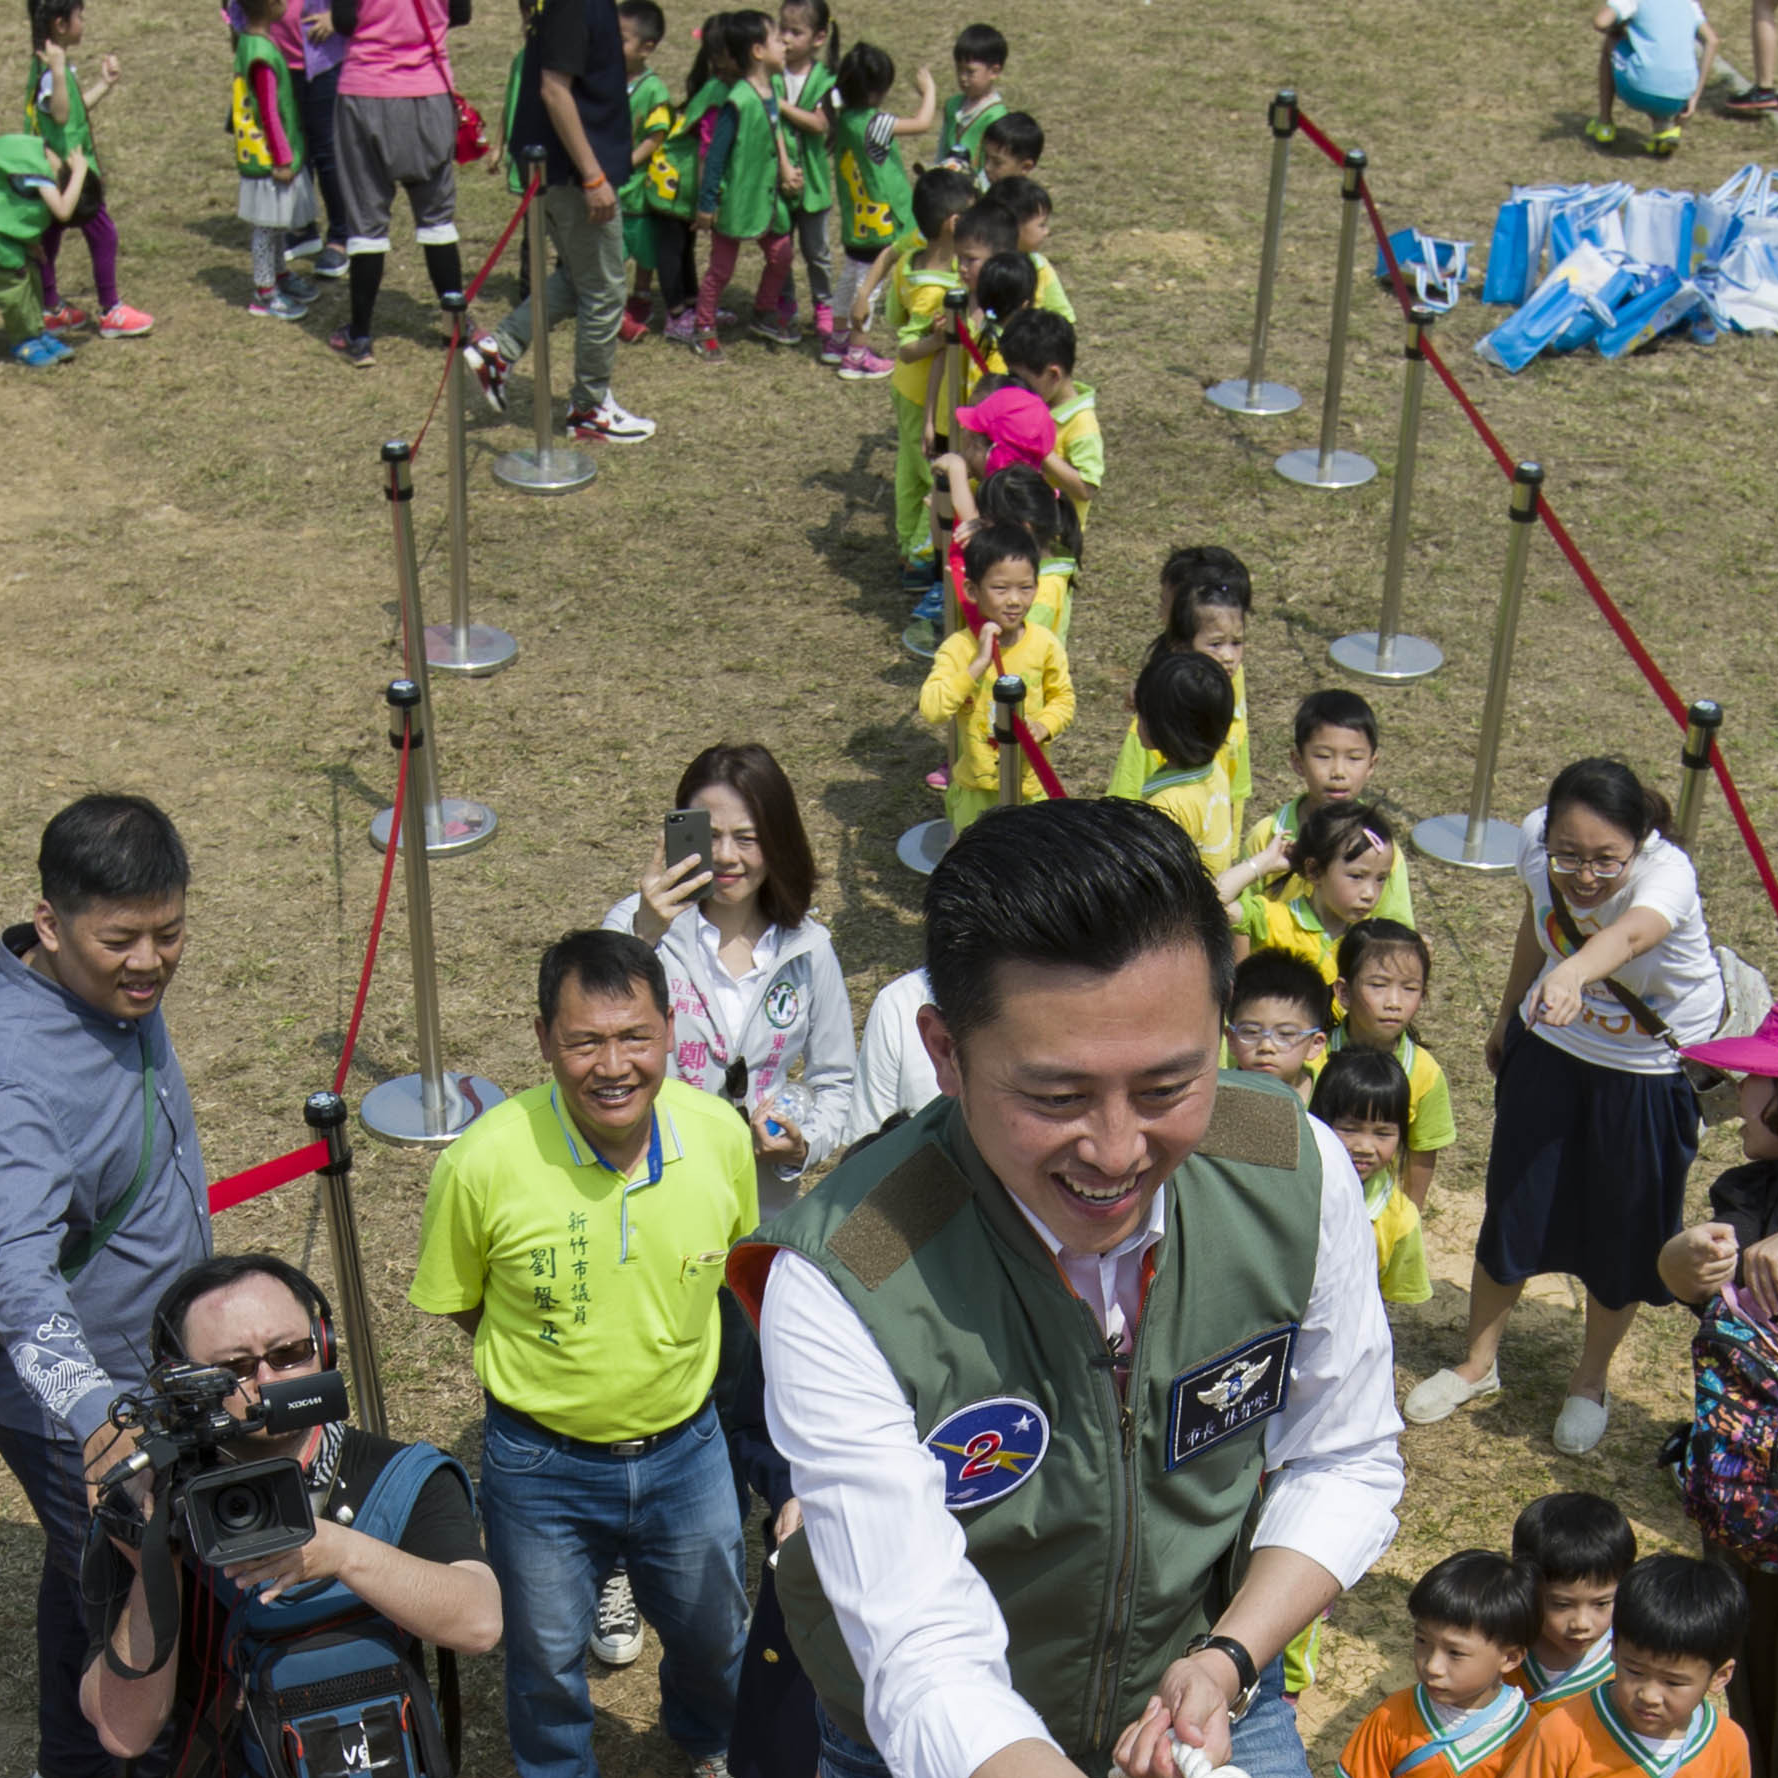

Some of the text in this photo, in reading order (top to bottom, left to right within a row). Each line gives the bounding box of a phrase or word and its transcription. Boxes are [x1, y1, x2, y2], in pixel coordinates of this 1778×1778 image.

[528, 1246, 561, 1347] 劉聲正
[567, 1210, 592, 1326] 新竹市議員
[958, 1430, 1004, 1482] 2
